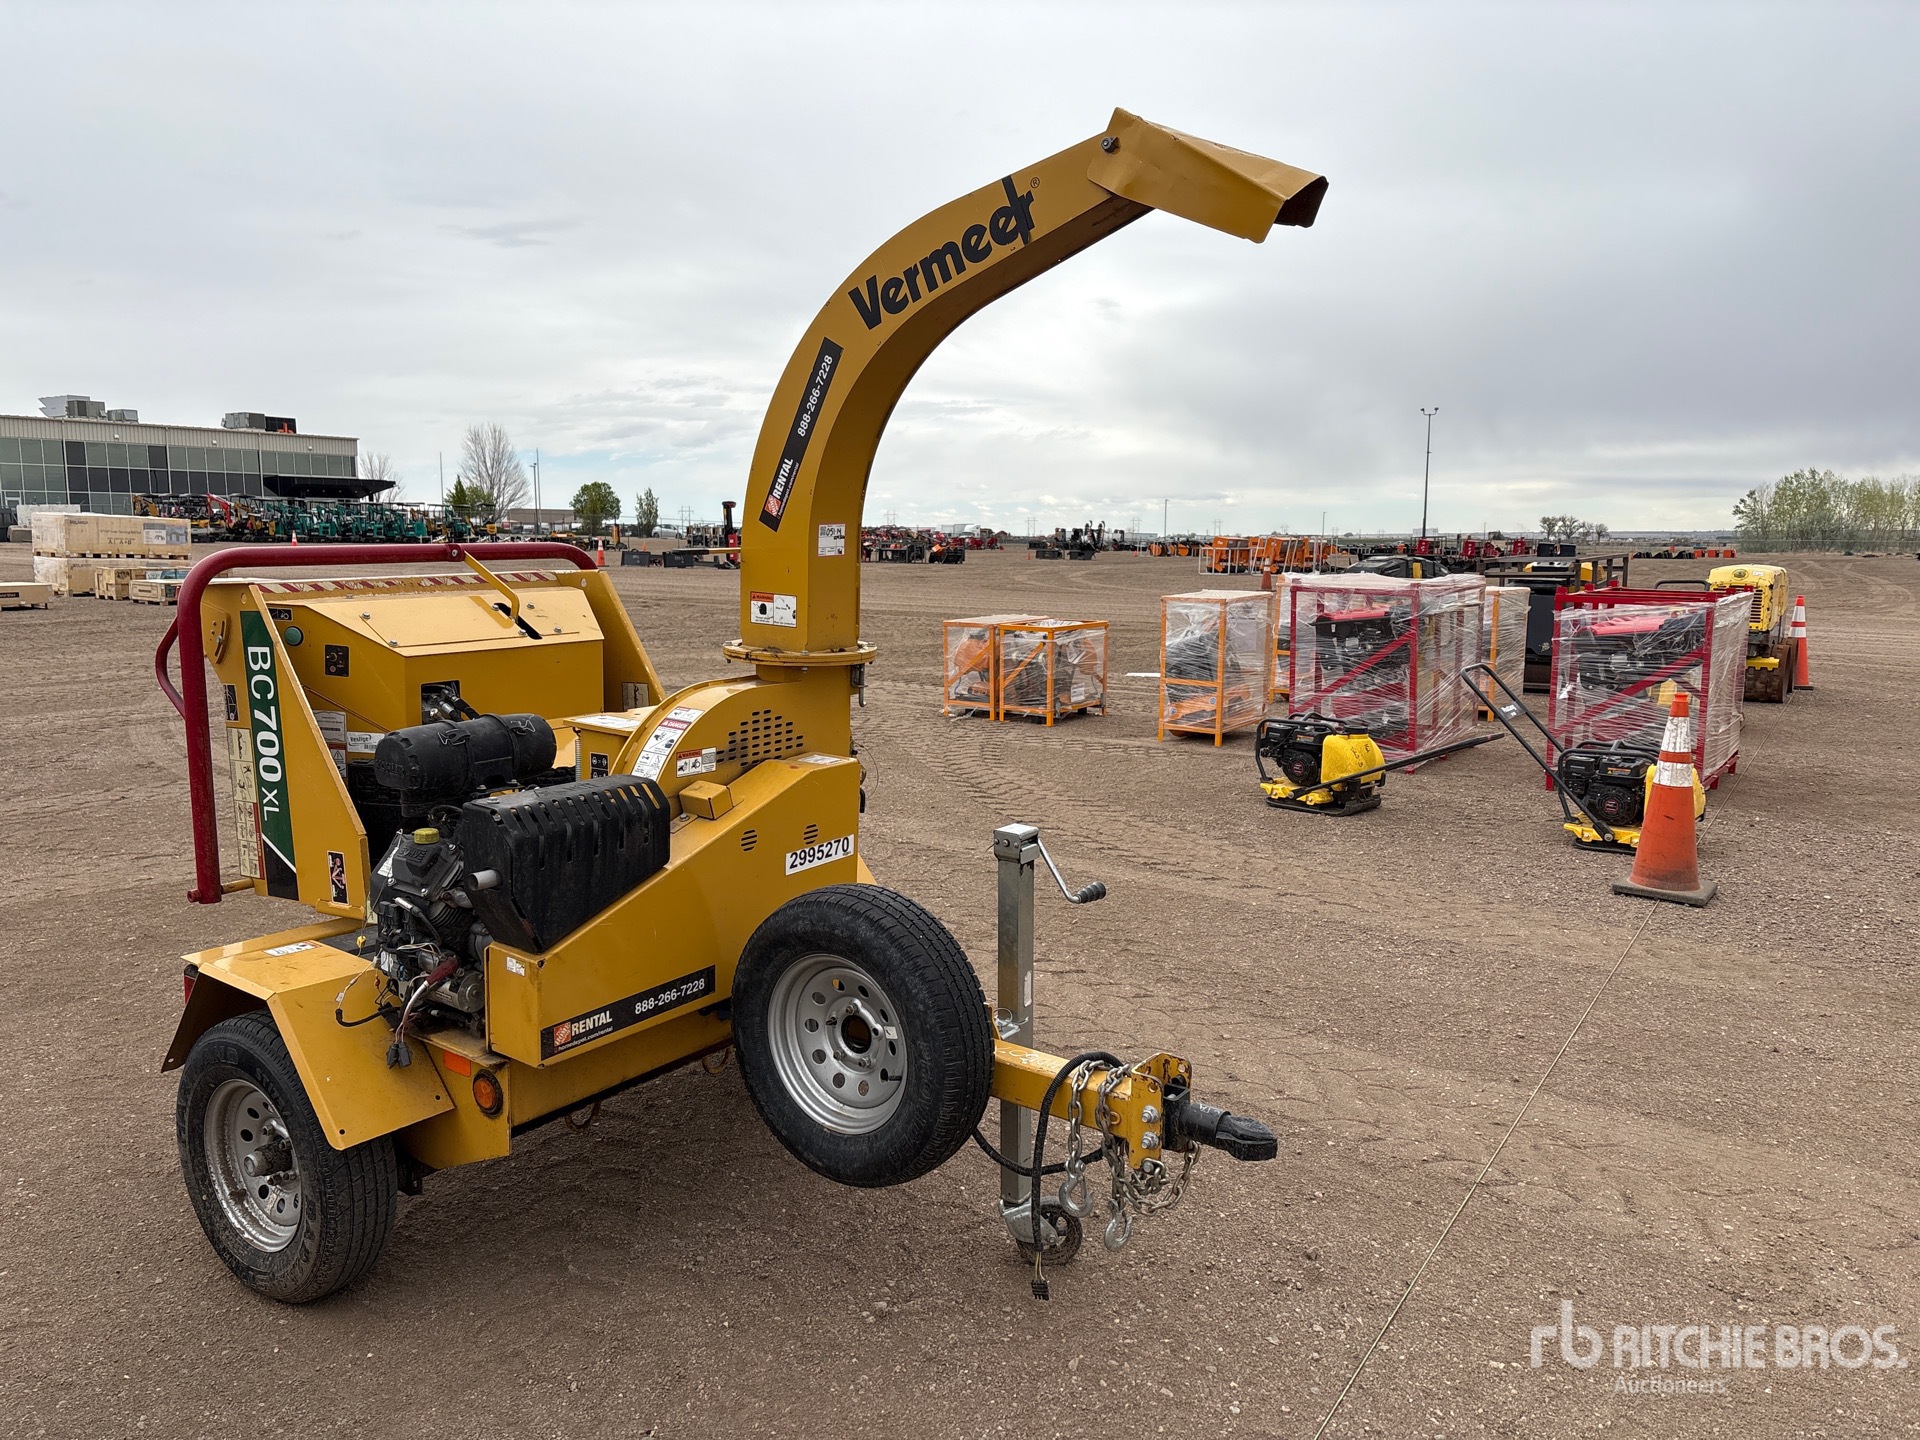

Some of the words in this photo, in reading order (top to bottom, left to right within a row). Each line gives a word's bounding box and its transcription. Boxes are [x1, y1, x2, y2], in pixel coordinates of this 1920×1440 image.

[797, 354, 833, 437] 888-266-7228
[772, 457, 794, 500] RENTAL
[667, 721, 688, 729] DANGER
[788, 836, 850, 870] 2995270
[634, 978, 706, 1016] 888-266-7228
[558, 1026, 613, 1051] homedepot.com/rental
[571, 1010, 613, 1037] RENTAL
